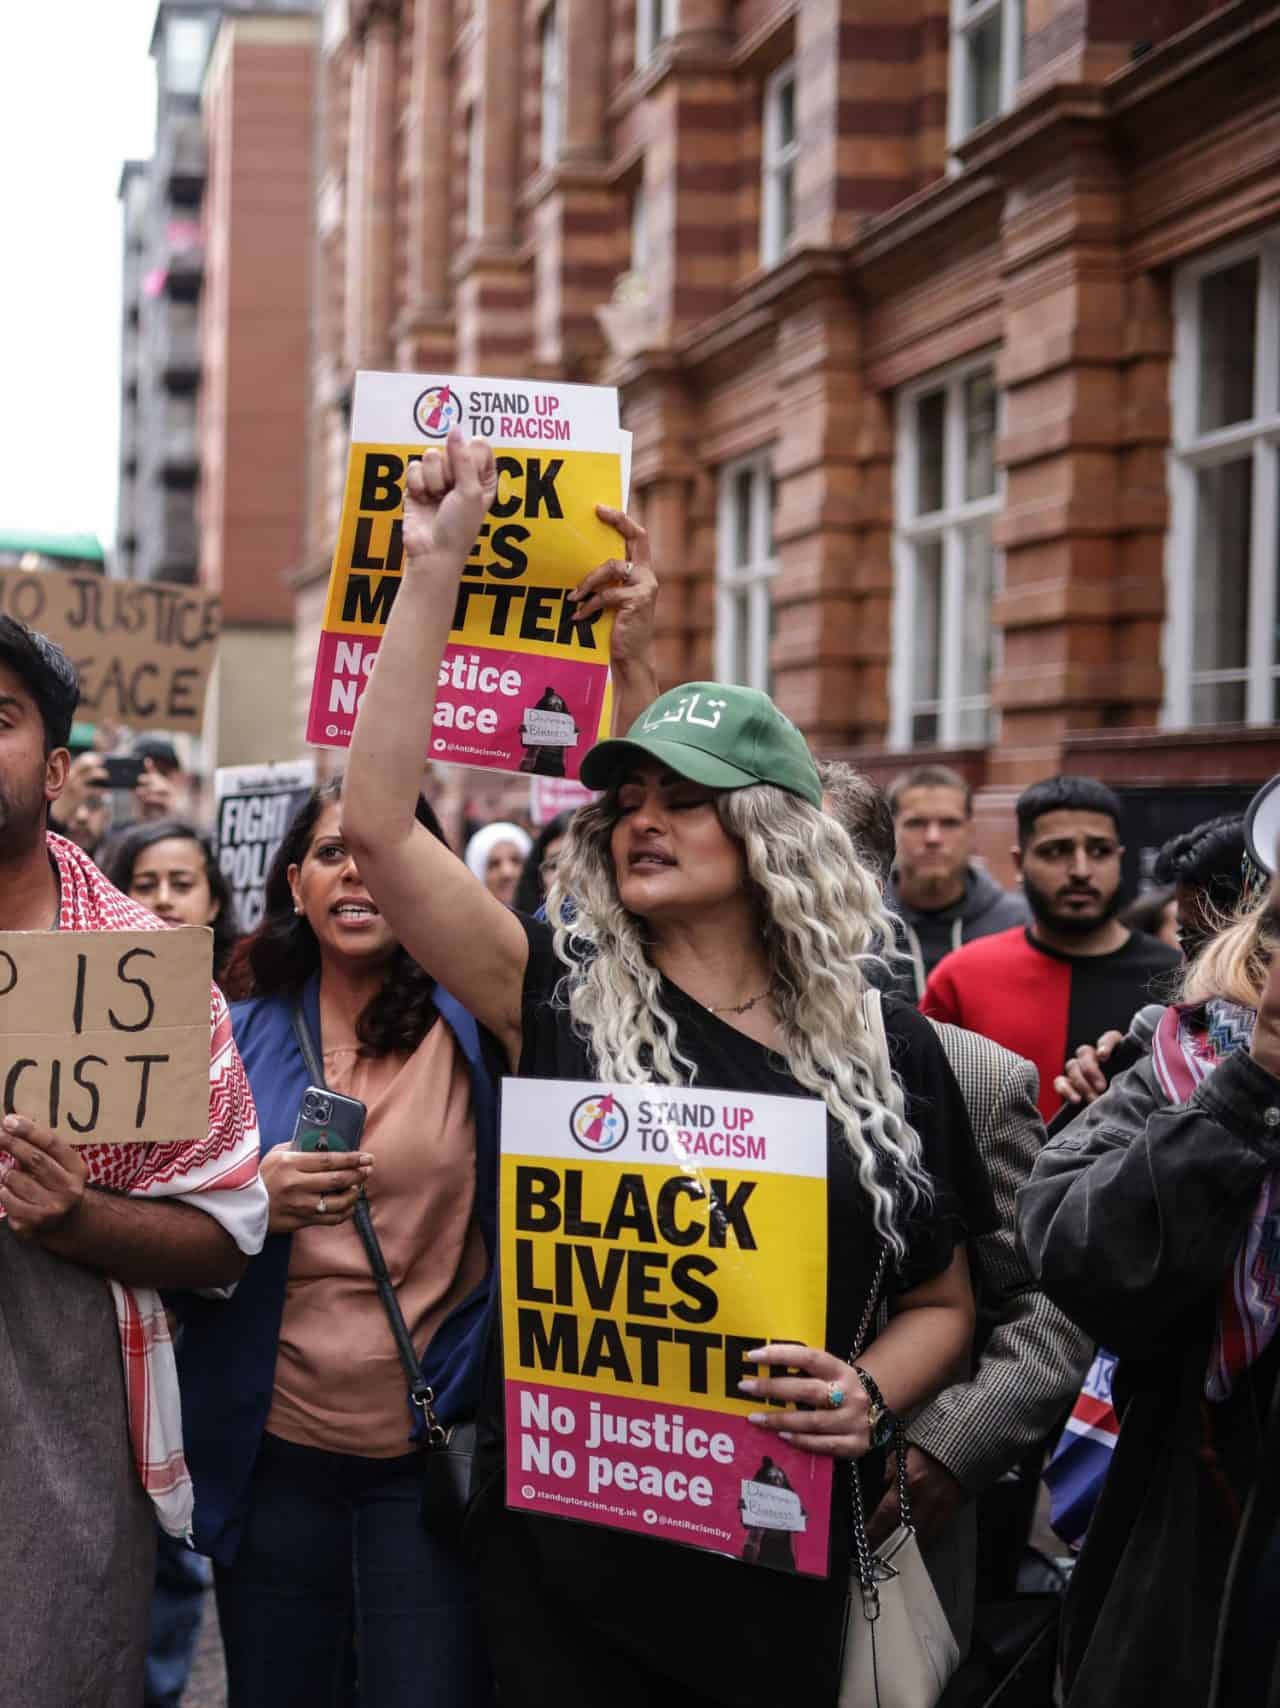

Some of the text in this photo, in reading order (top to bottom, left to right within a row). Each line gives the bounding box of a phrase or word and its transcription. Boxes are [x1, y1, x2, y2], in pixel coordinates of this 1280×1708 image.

[468, 415, 570, 441] TO RACISM
[469, 391, 559, 417] STAND UP
[65, 576, 223, 649] JUSTICE
[341, 574, 603, 649] MTTER
[78, 655, 200, 718] EACE
[437, 655, 521, 697] stice
[328, 679, 367, 714] N
[432, 701, 498, 734] ace
[221, 793, 293, 846] FIGHT
[73, 947, 156, 1034] IS
[637, 1127, 766, 1161] TO RACISM
[638, 1101, 754, 1131] STAND UP
[515, 1165, 758, 1251] BLACK
[515, 1238, 719, 1324] LIVES
[520, 1390, 735, 1464] No justice
[520, 1433, 577, 1479] No
[588, 1455, 713, 1507] peace
[537, 1490, 732, 1541] standuptoracism.org.uk @AntiRacismDay
